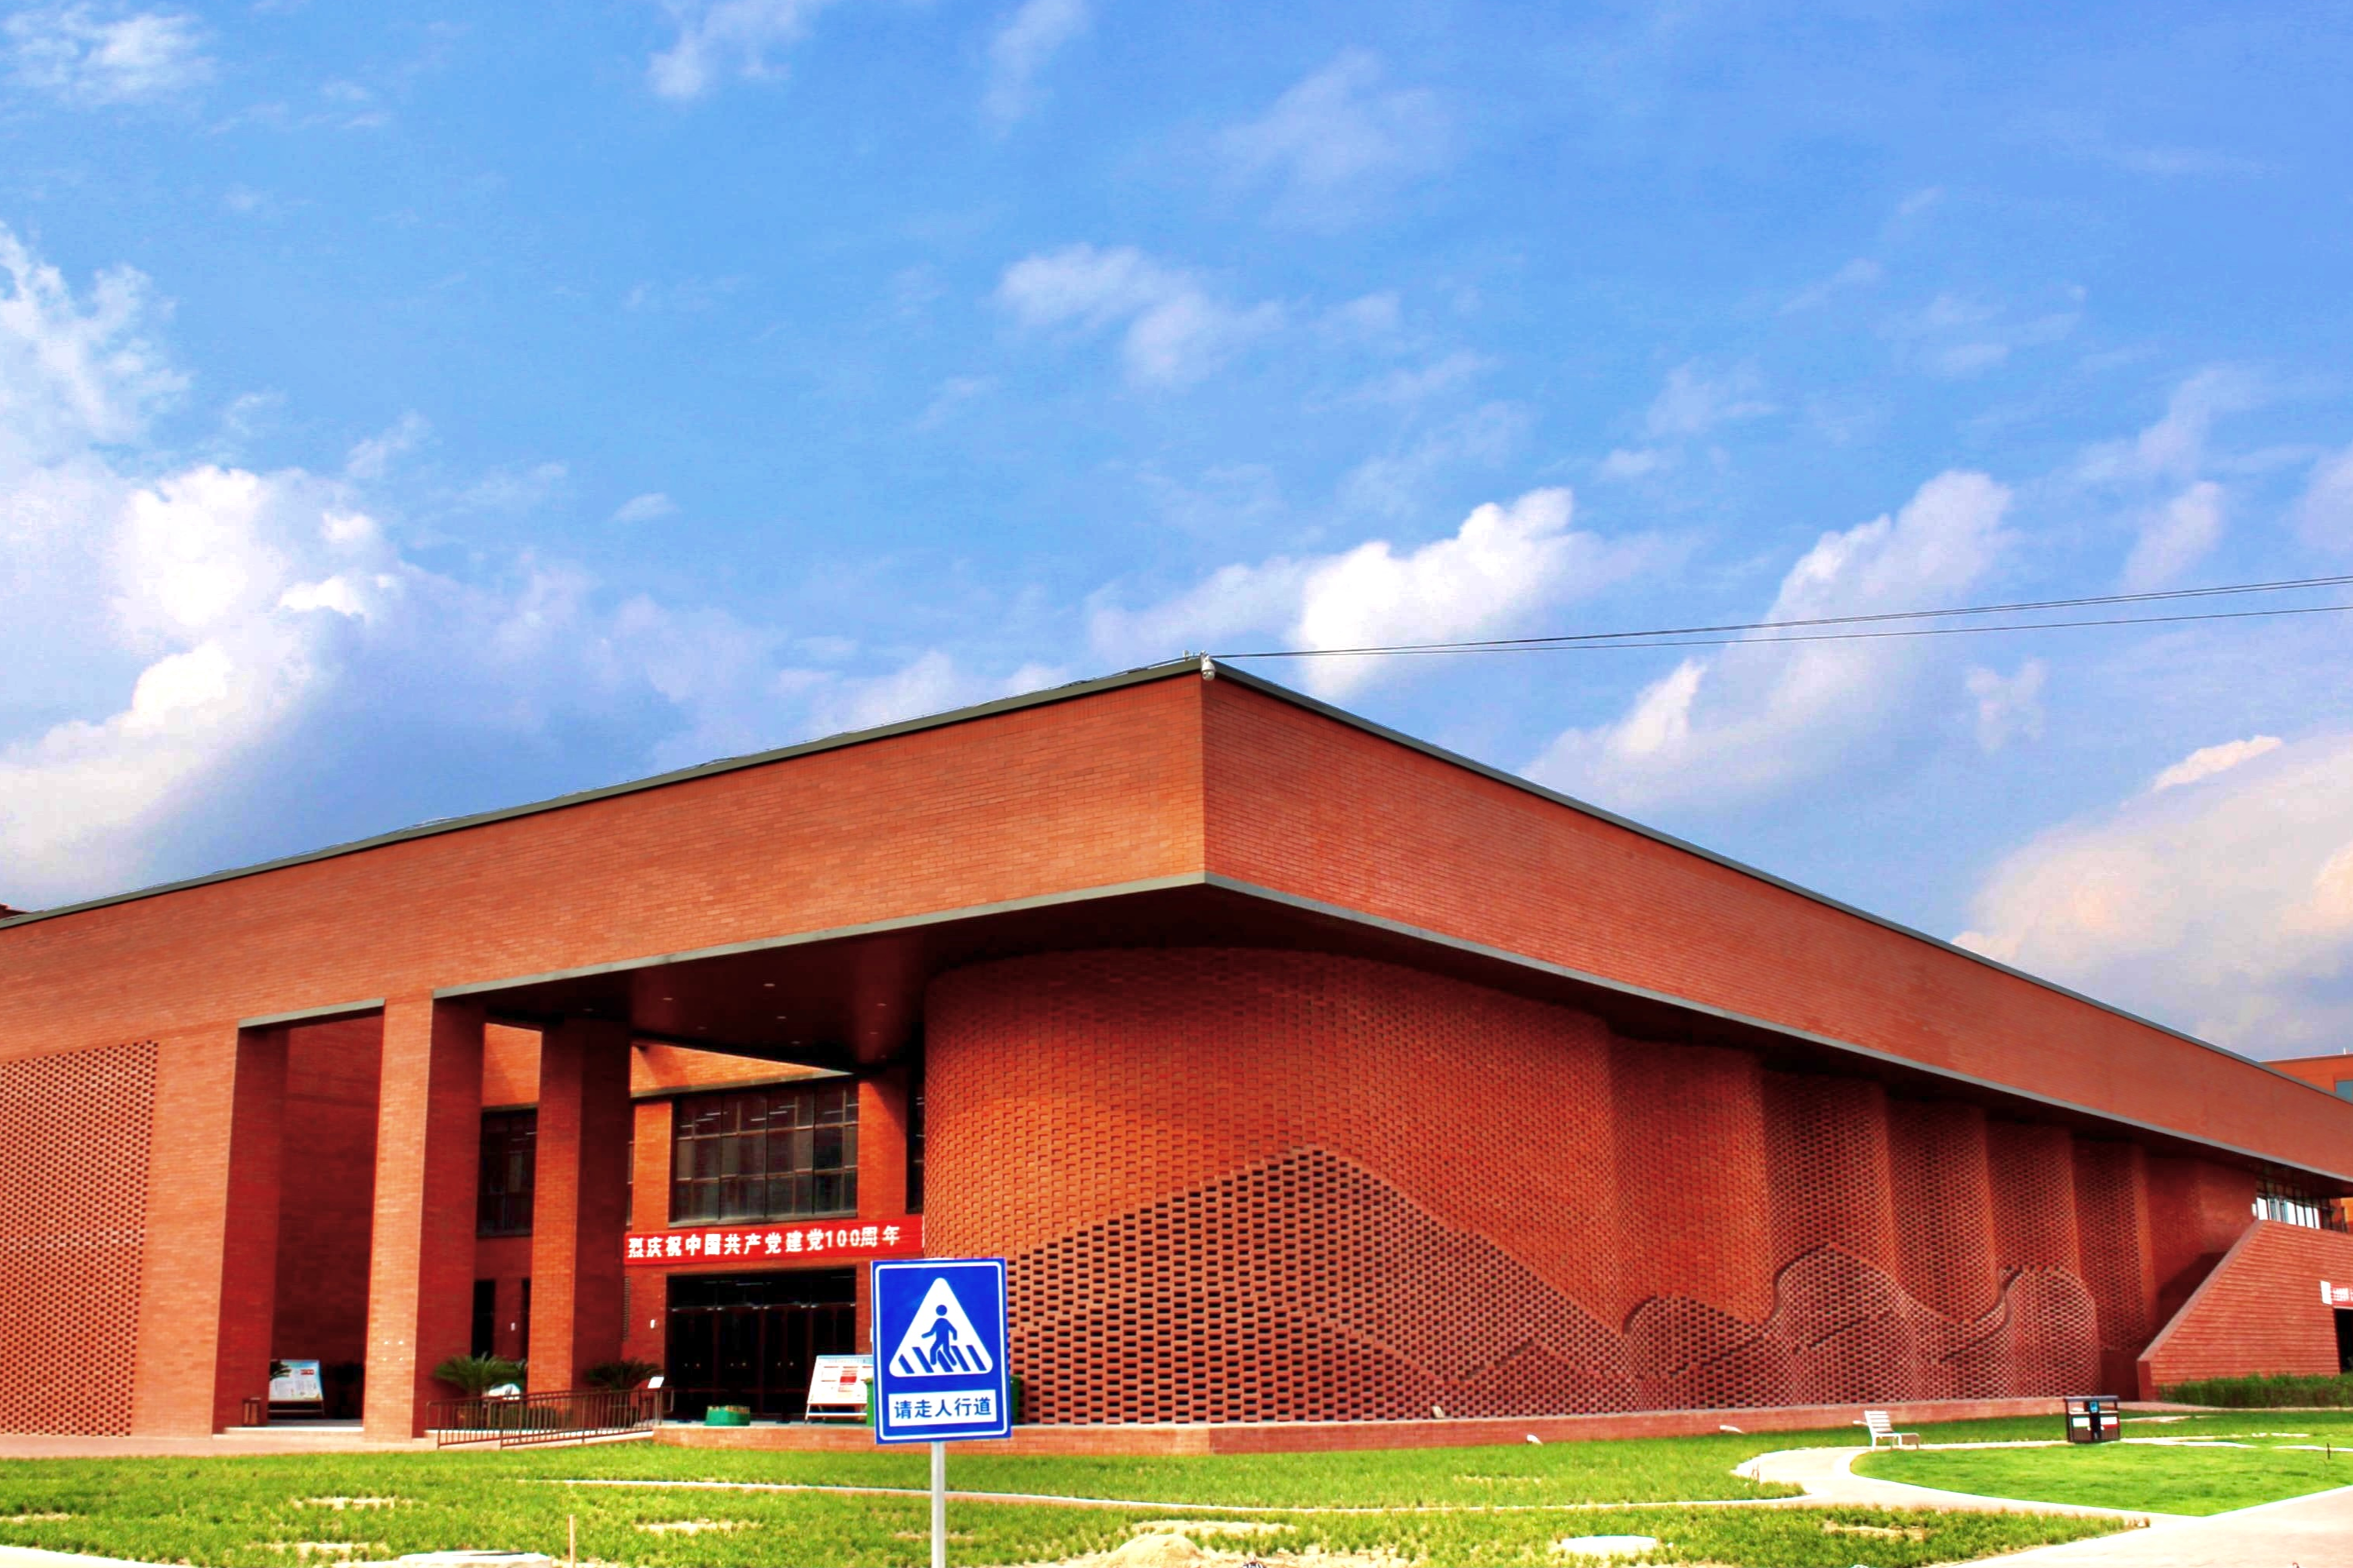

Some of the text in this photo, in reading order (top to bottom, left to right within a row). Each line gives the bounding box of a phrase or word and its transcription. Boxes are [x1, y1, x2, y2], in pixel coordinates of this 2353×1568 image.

[894, 1397, 992, 1419] 请走人行道
